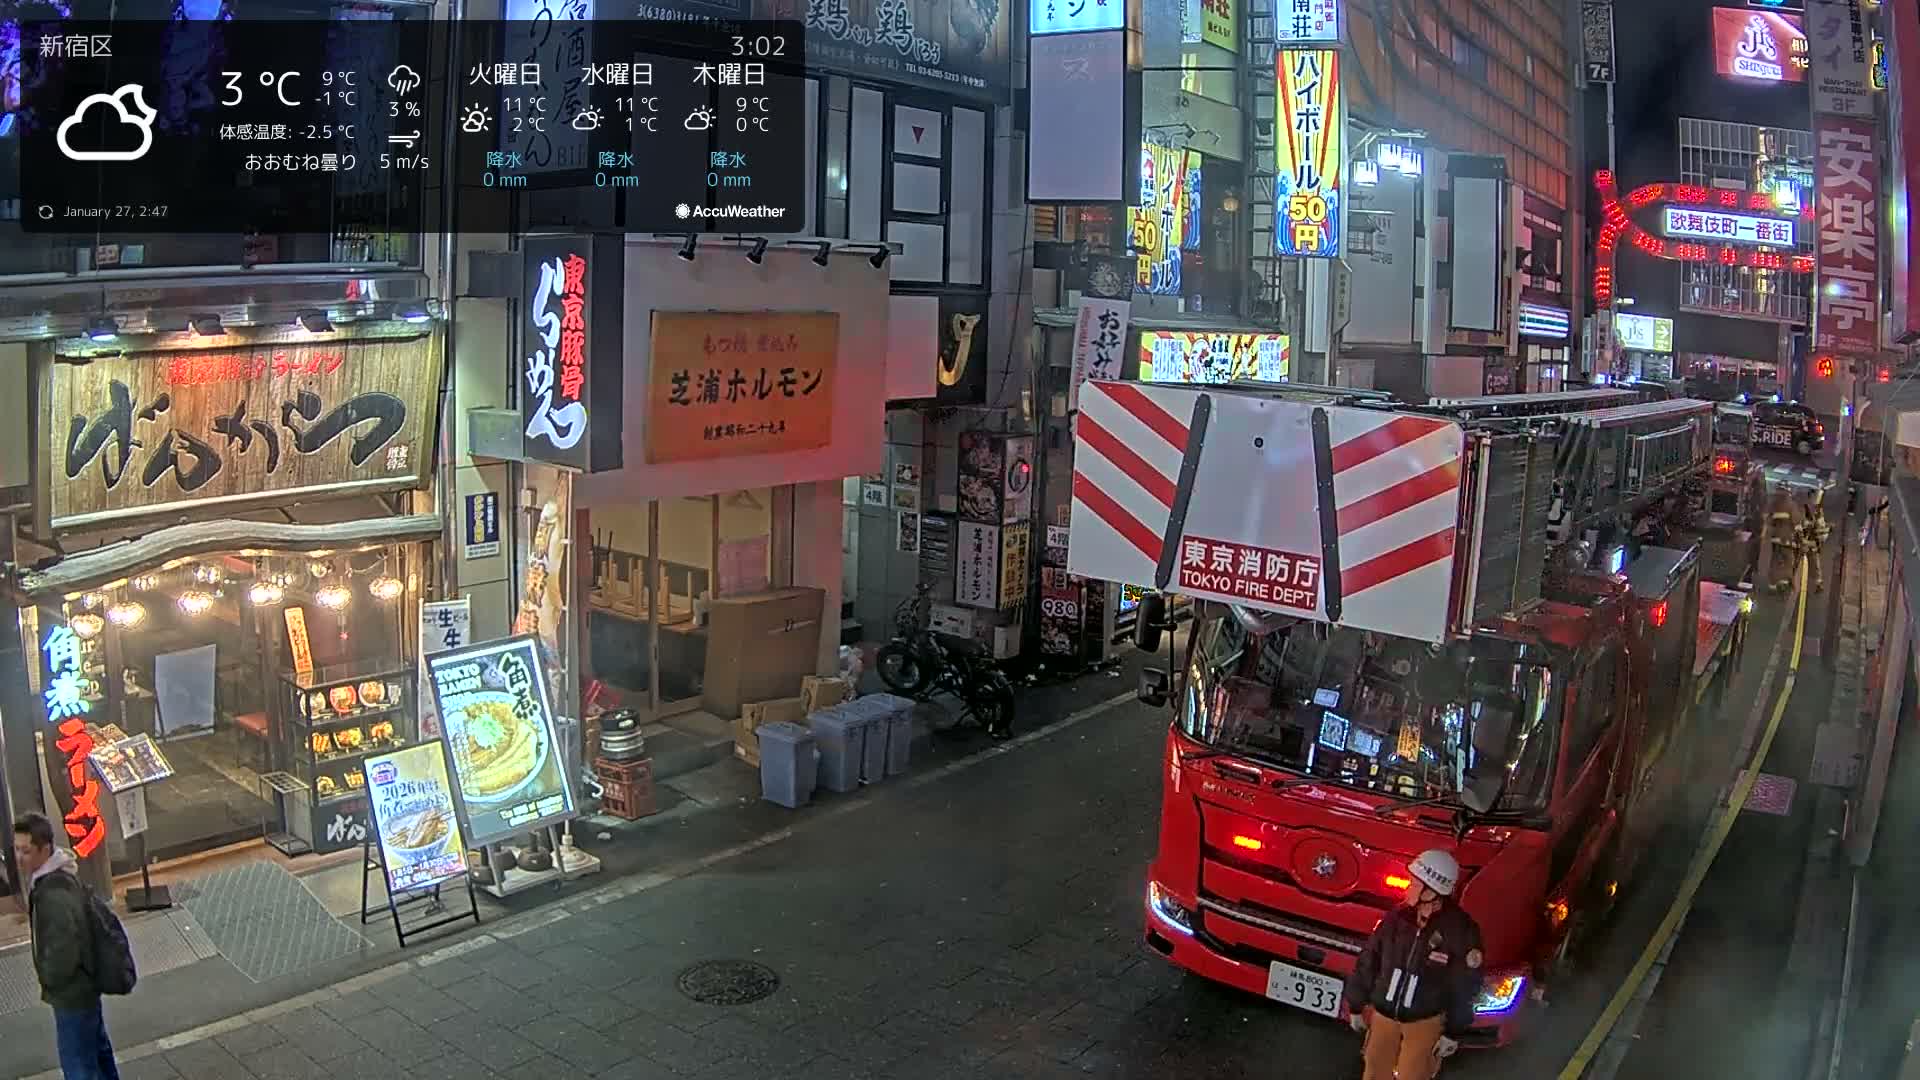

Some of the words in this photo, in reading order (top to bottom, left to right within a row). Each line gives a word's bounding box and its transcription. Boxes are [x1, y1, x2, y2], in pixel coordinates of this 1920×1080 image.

[1589, 64, 1609, 79] 7F
[1295, 50, 1322, 190] ハイボール
[1160, 154, 1174, 288] ハイボール
[1289, 196, 1326, 223] 50
[1671, 212, 1789, 243] 歌舞伎町一番街
[1819, 128, 1875, 330] 安楽亭
[1134, 220, 1156, 251] 50
[1294, 225, 1321, 251] 円
[561, 254, 586, 400] 東京豚骨
[669, 367, 823, 406] 芝浦ホルモン
[66, 379, 406, 492] ばんから
[1183, 540, 1319, 587] 東京消防庁
[1183, 569, 1231, 591] TOKYO
[1235, 580, 1269, 598] FIRE
[1273, 586, 1315, 608] DEPT.
[435, 663, 480, 682] TOKYO
[501, 654, 540, 720] 角煮
[1293, 982, 1337, 1011] 933
